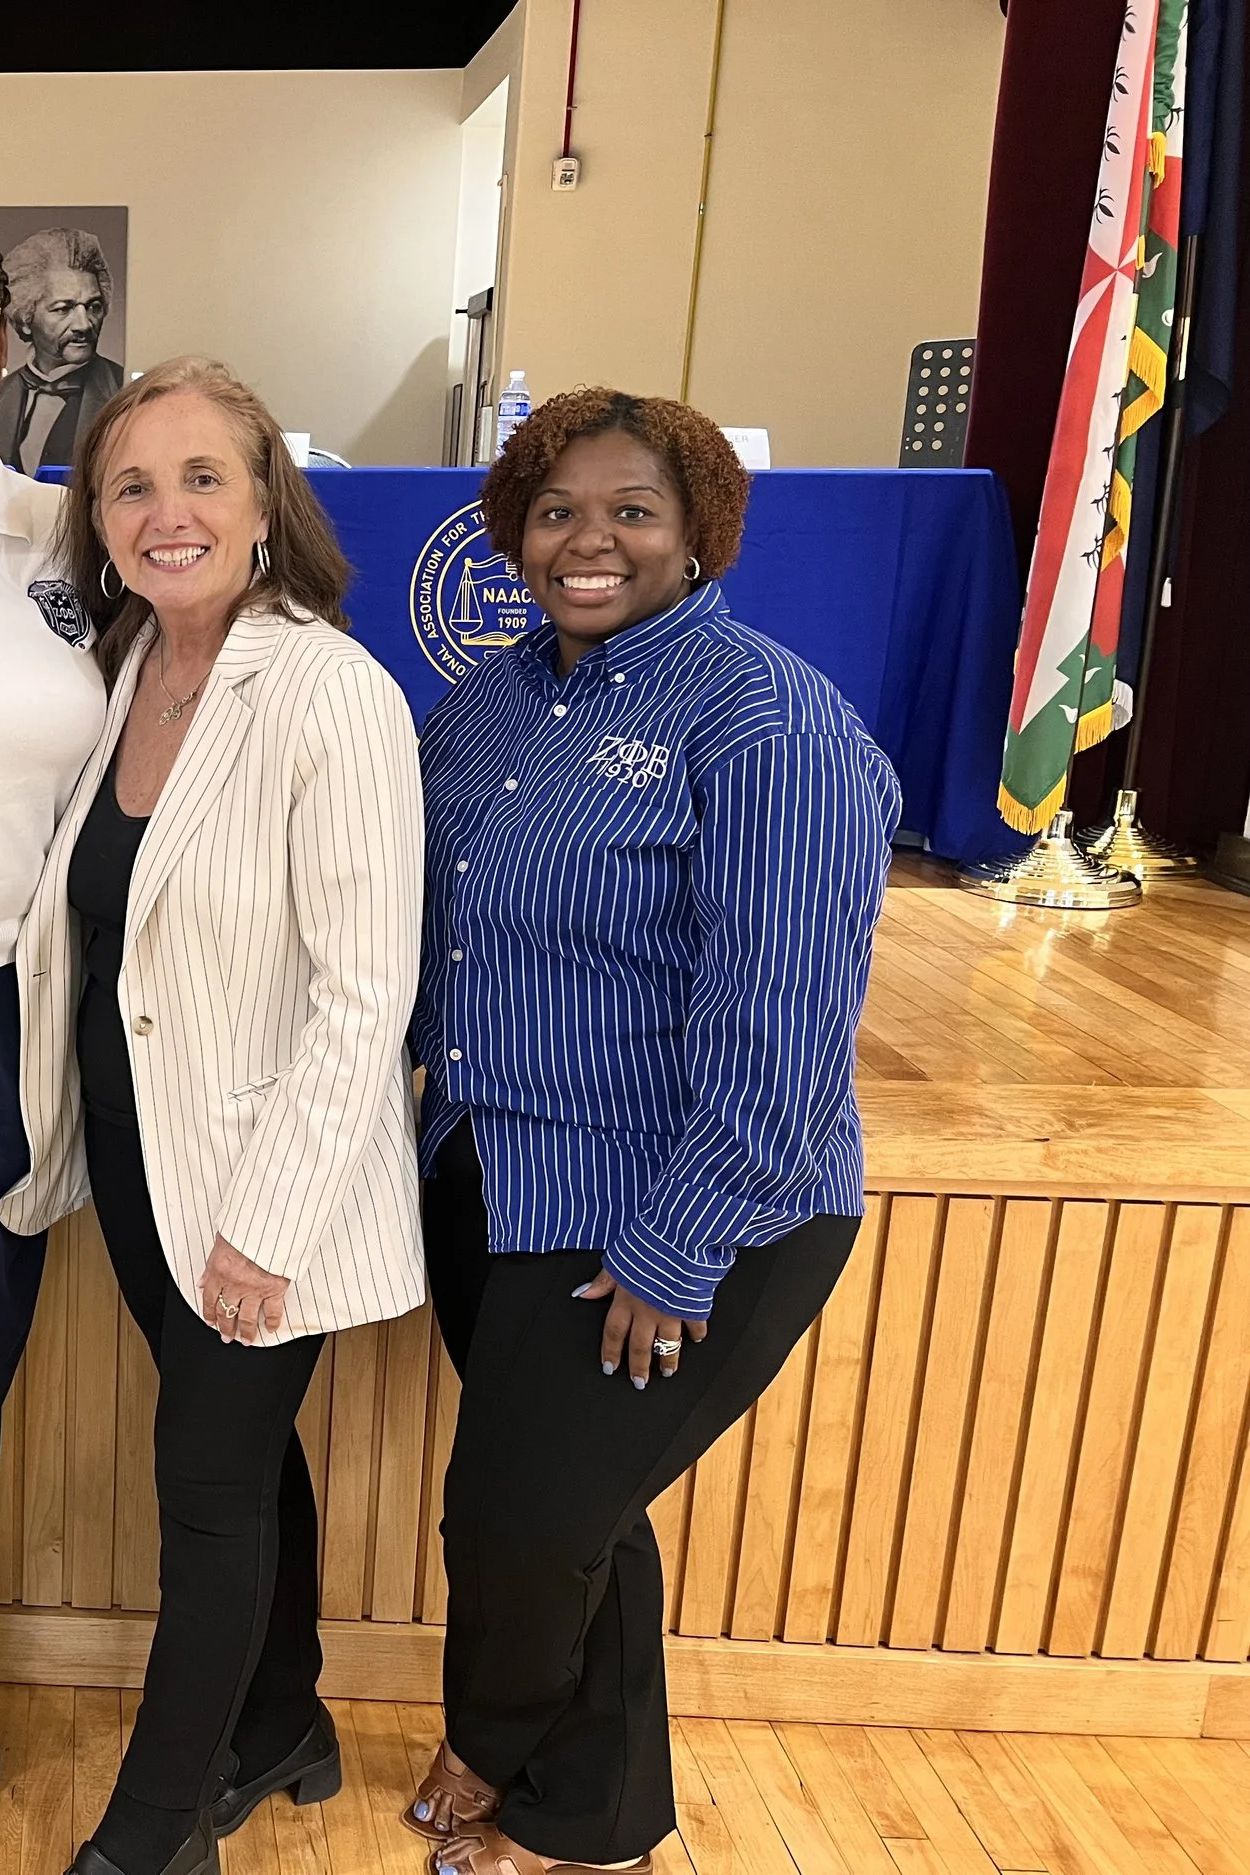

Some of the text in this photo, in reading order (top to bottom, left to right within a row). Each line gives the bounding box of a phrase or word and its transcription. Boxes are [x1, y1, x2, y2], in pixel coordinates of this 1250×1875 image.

[728, 434, 749, 443] SER
[441, 522, 468, 547] FOR
[419, 549, 445, 640] ASSOCIATION
[483, 587, 537, 604] NAAC
[497, 617, 528, 629] 1909
[436, 643, 467, 676] ONAL
[596, 760, 648, 788] 1920
